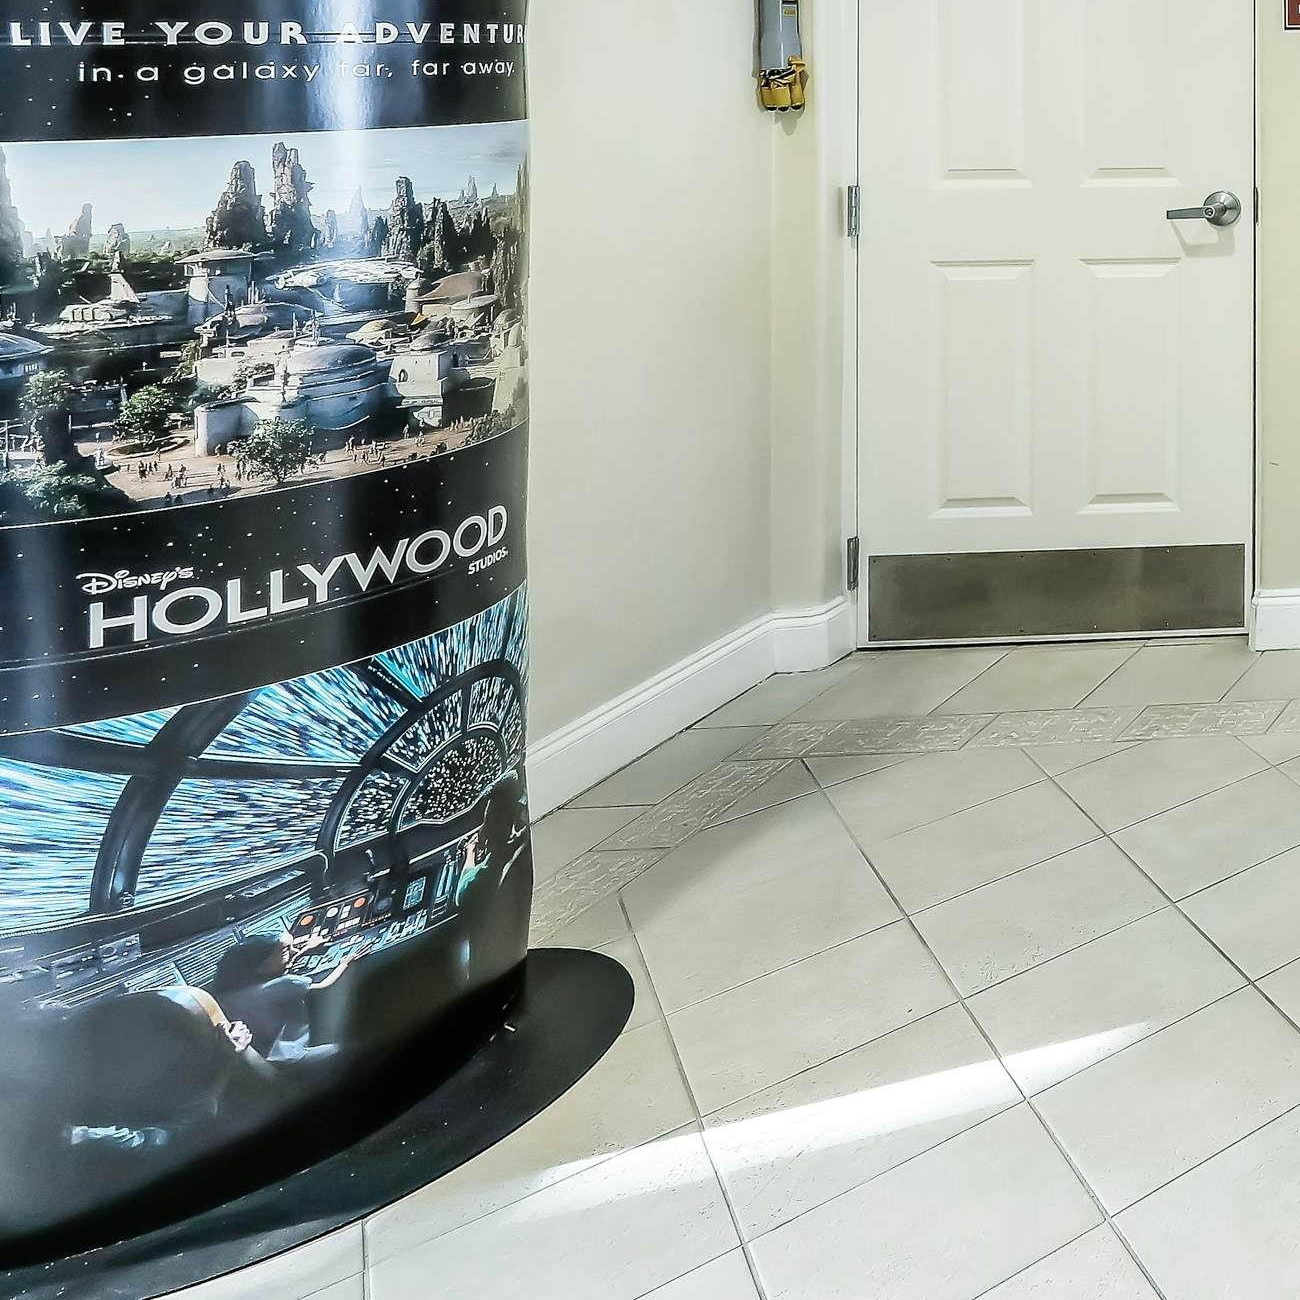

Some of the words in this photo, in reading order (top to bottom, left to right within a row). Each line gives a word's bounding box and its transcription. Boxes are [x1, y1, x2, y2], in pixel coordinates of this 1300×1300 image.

[10, 21, 126, 46] LIVE
[150, 21, 306, 46] YOUR
[88, 505, 509, 649] HOLLYWOOD
